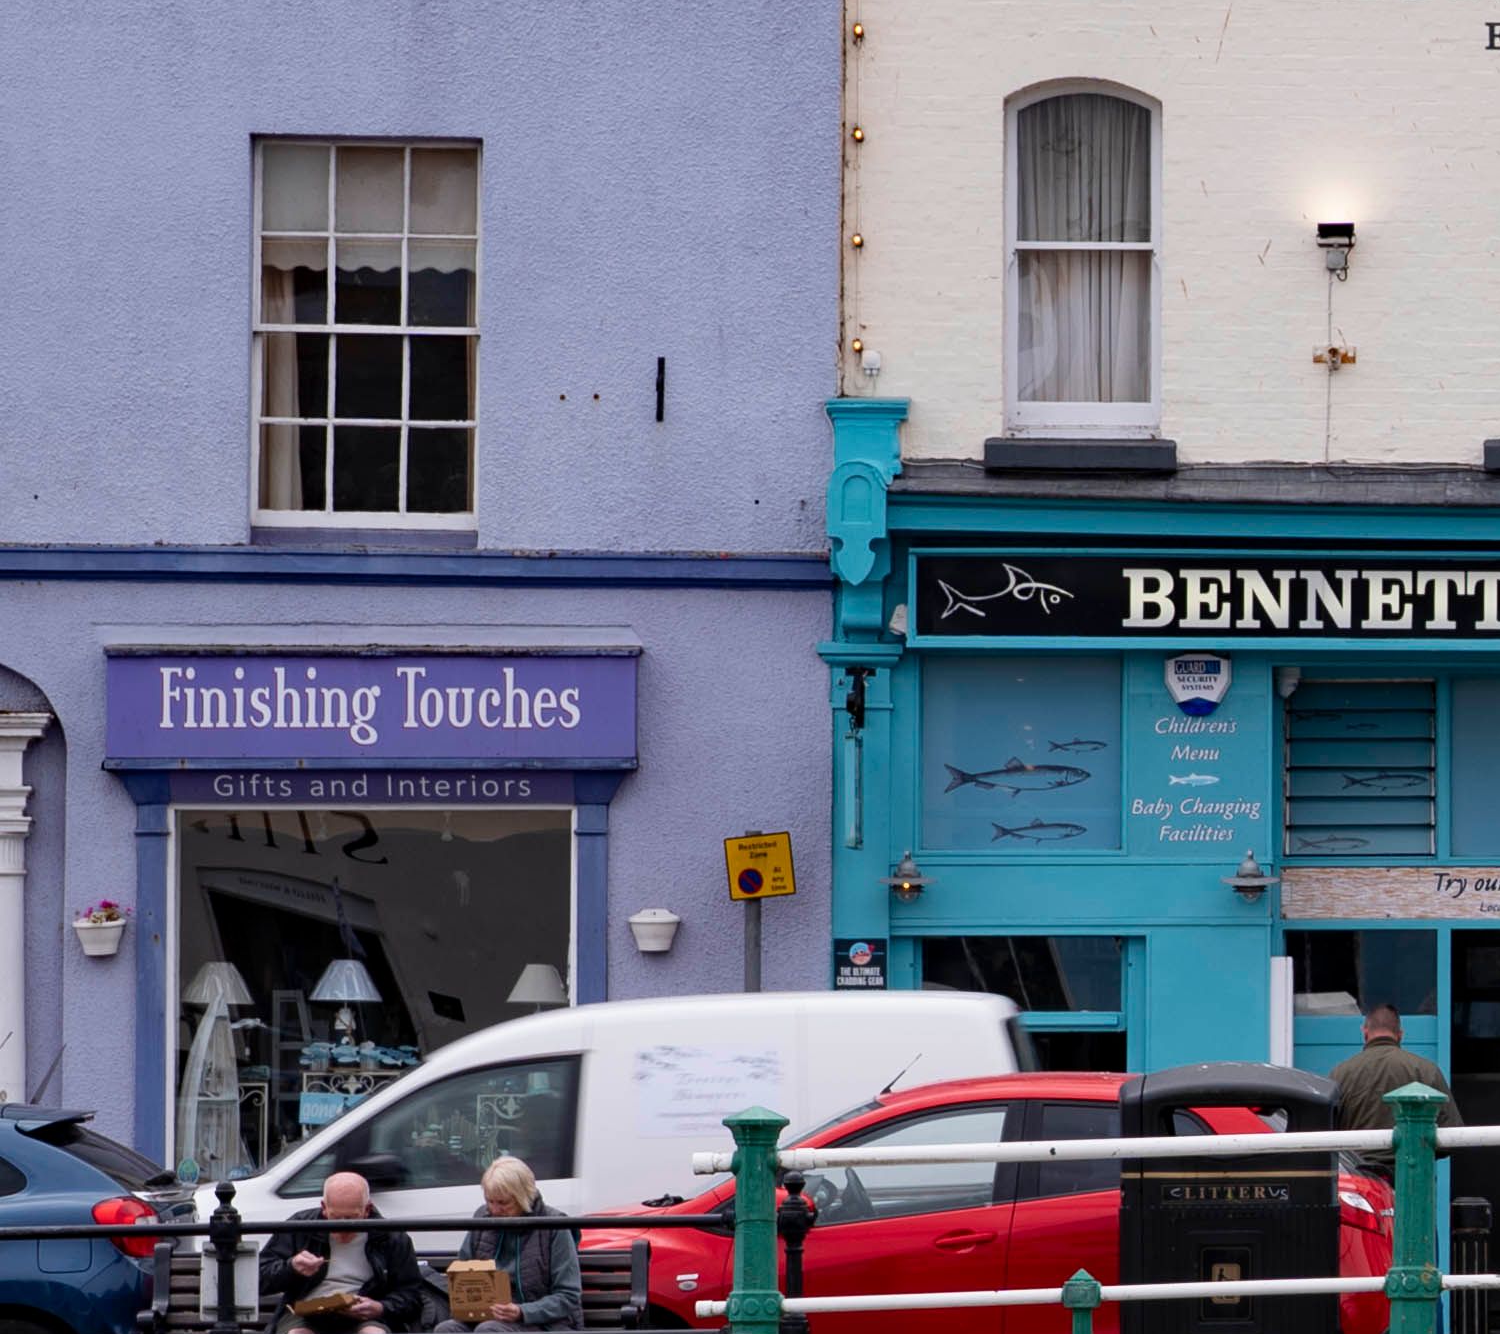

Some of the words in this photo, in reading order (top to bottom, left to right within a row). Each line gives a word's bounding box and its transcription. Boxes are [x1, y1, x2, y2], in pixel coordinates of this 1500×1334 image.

[160, 667, 380, 744] Finishing
[397, 667, 580, 727] Touches
[1155, 717, 1236, 734] Children's
[1171, 746, 1219, 760] Menu
[214, 774, 291, 796] Gifts
[311, 775, 367, 796] and
[388, 775, 530, 796] Interiors
[1132, 798, 1173, 820] Baby
[1180, 797, 1260, 820] Changing
[1160, 825, 1233, 841] Facilities
[738, 841, 777, 850] Restricted
[1434, 873, 1467, 898] Try
